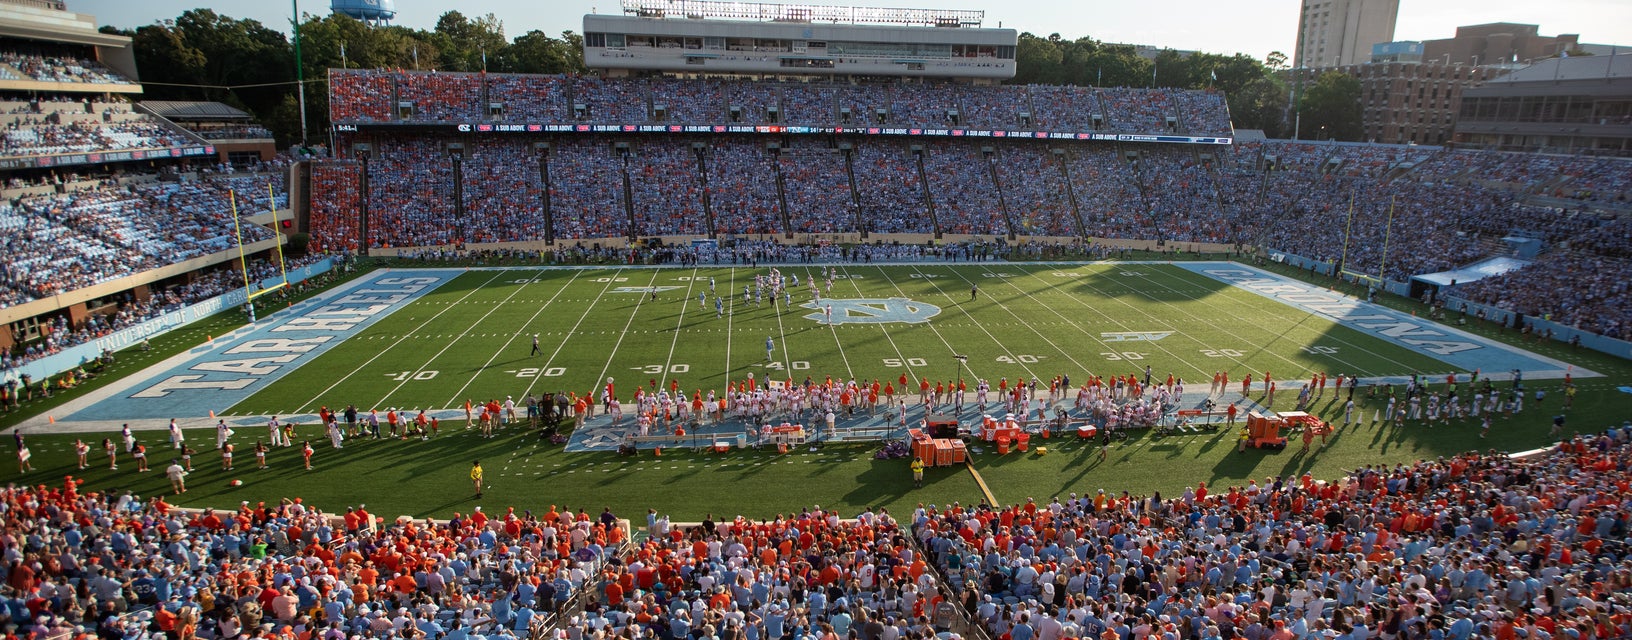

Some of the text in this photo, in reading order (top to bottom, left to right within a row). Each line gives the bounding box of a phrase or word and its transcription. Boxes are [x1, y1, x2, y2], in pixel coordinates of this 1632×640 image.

[1200, 269, 1484, 356] CAROLINA
[94, 315, 170, 351] UNIVERSITY
[174, 311, 187, 324] OF
[192, 297, 222, 318] NORTH
[127, 276, 443, 399] TAR HEELS
[1100, 352, 1144, 360] 30
[1199, 349, 1244, 357] 20
[882, 357, 928, 367] 50
[996, 354, 1039, 364] 40
[643, 364, 690, 374] 30
[765, 361, 810, 371] 40
[393, 370, 440, 381] 10
[516, 368, 566, 378] 20
